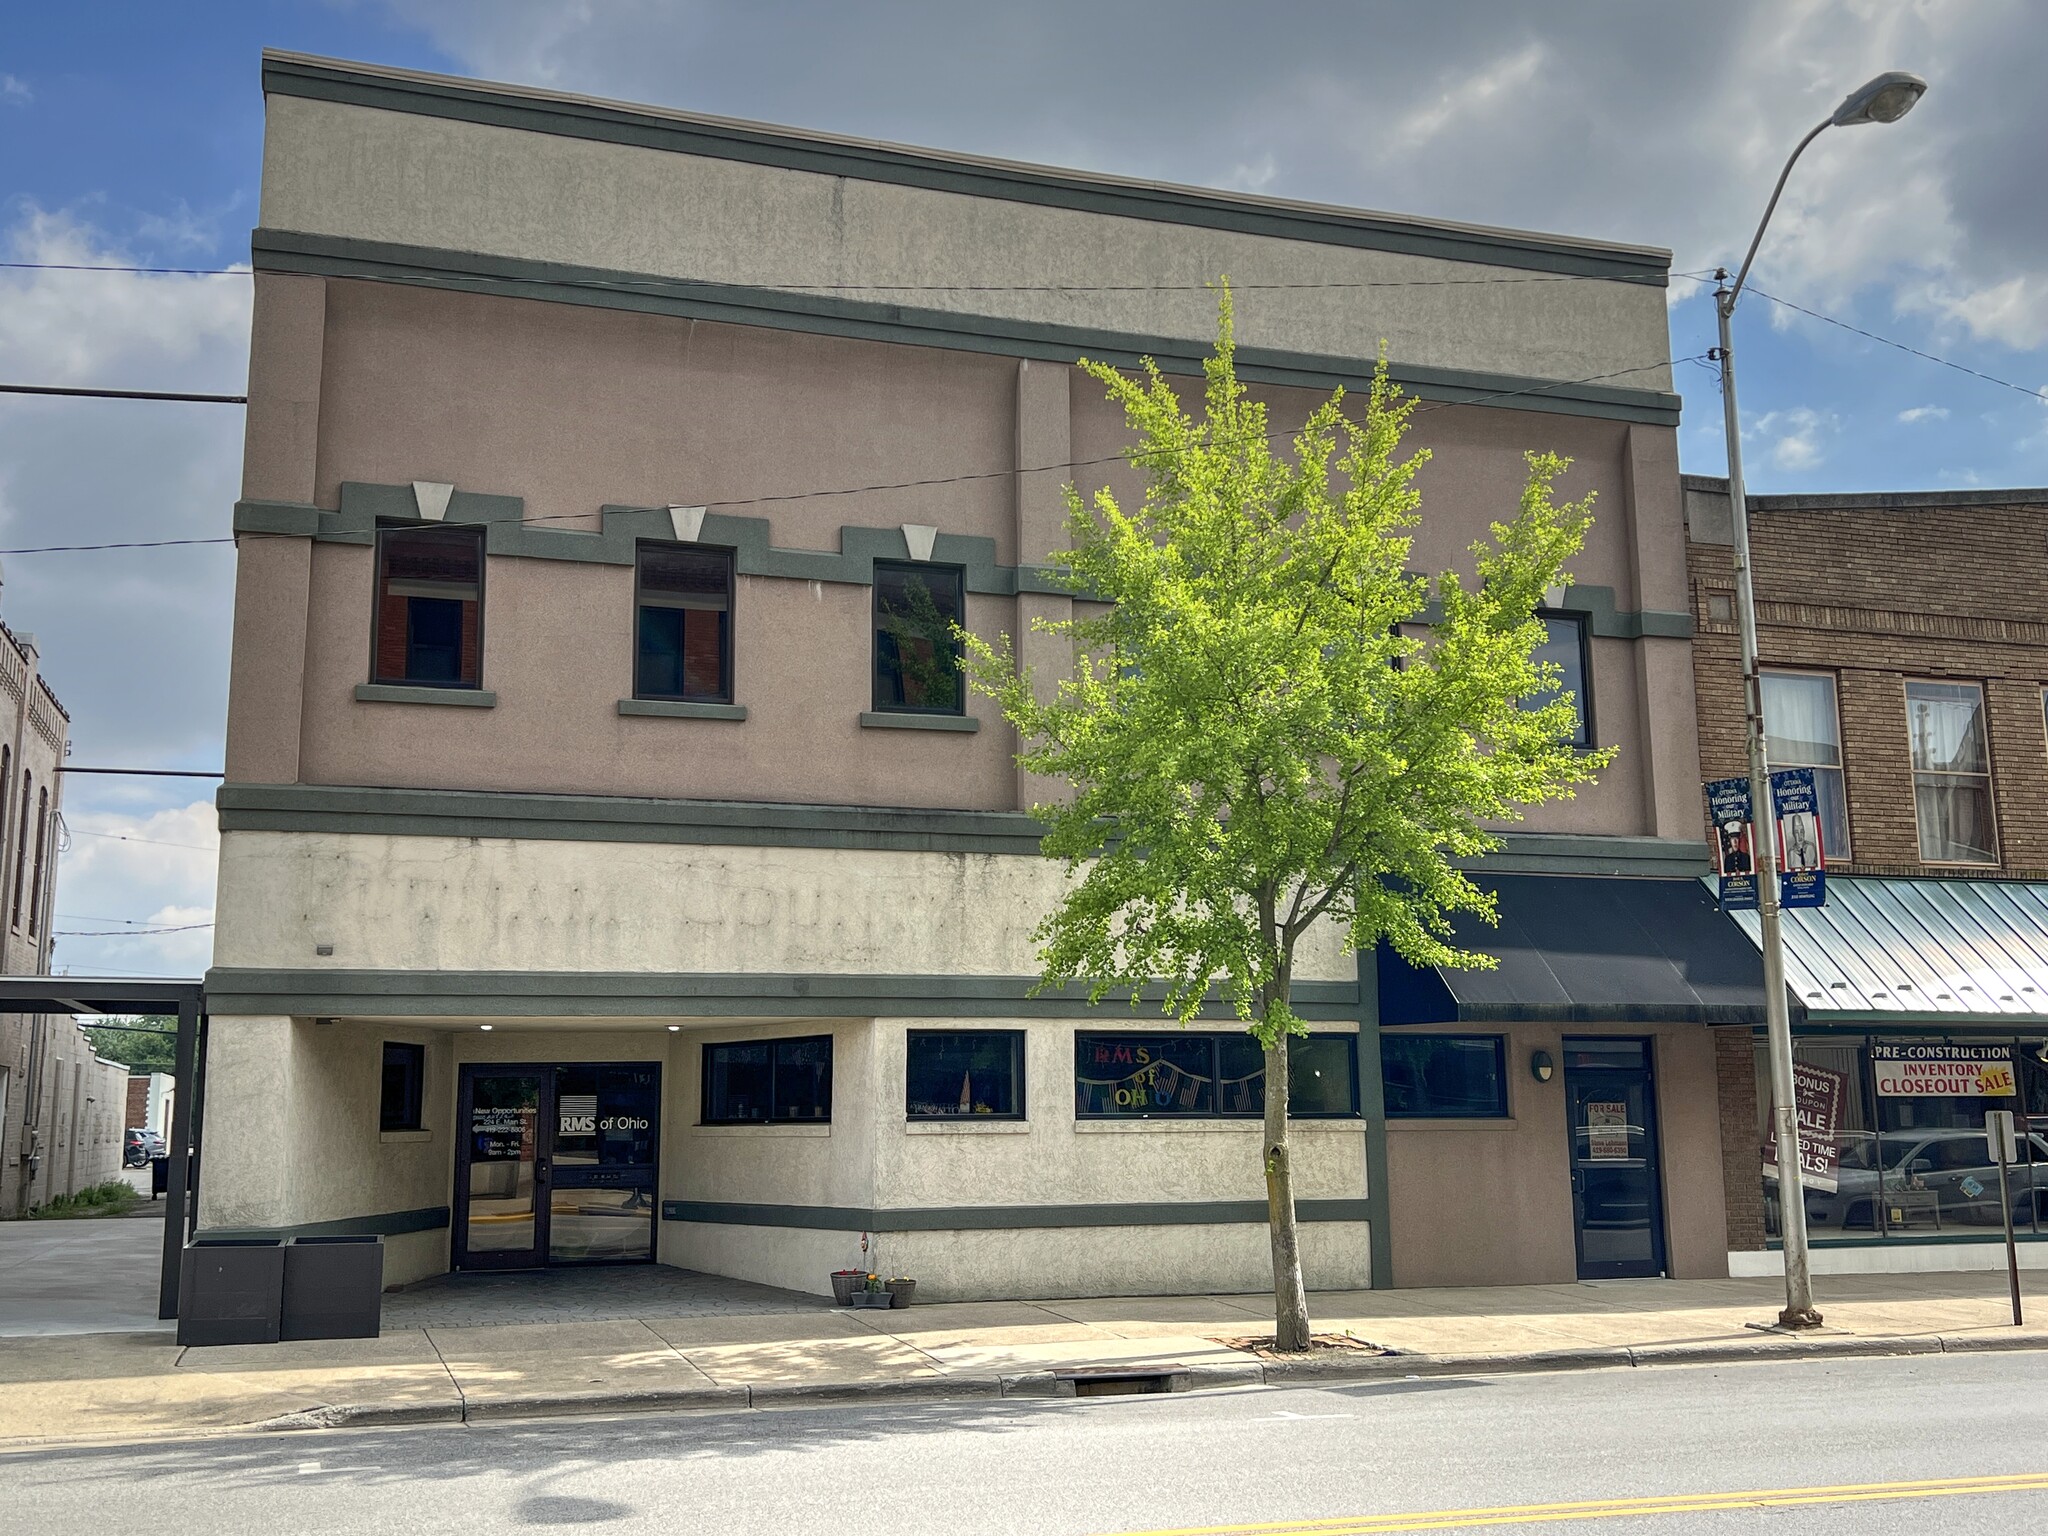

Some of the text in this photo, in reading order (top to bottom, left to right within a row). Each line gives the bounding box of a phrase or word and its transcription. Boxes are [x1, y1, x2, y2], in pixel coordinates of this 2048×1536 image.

[1777, 785, 1812, 797] Honoring
[1711, 794, 1748, 805] Honoring
[1782, 801, 1810, 811] Military
[1717, 809, 1745, 819] Military
[1875, 1046, 2010, 1059] PRE-CONSTRUCTION
[1904, 1064, 1983, 1076] INVENTORY
[1135, 1067, 1156, 1086] of
[1880, 1072, 2012, 1093] CLOSEOUT SALE
[1589, 1104, 1625, 1113] FOR SALE
[1796, 1096, 1826, 1110] OUPON
[492, 1107, 537, 1115] Opportunities
[560, 1117, 649, 1132] RMS of Ohio
[1797, 1109, 1827, 1130] ALE
[1812, 1142, 1836, 1158] TIME
